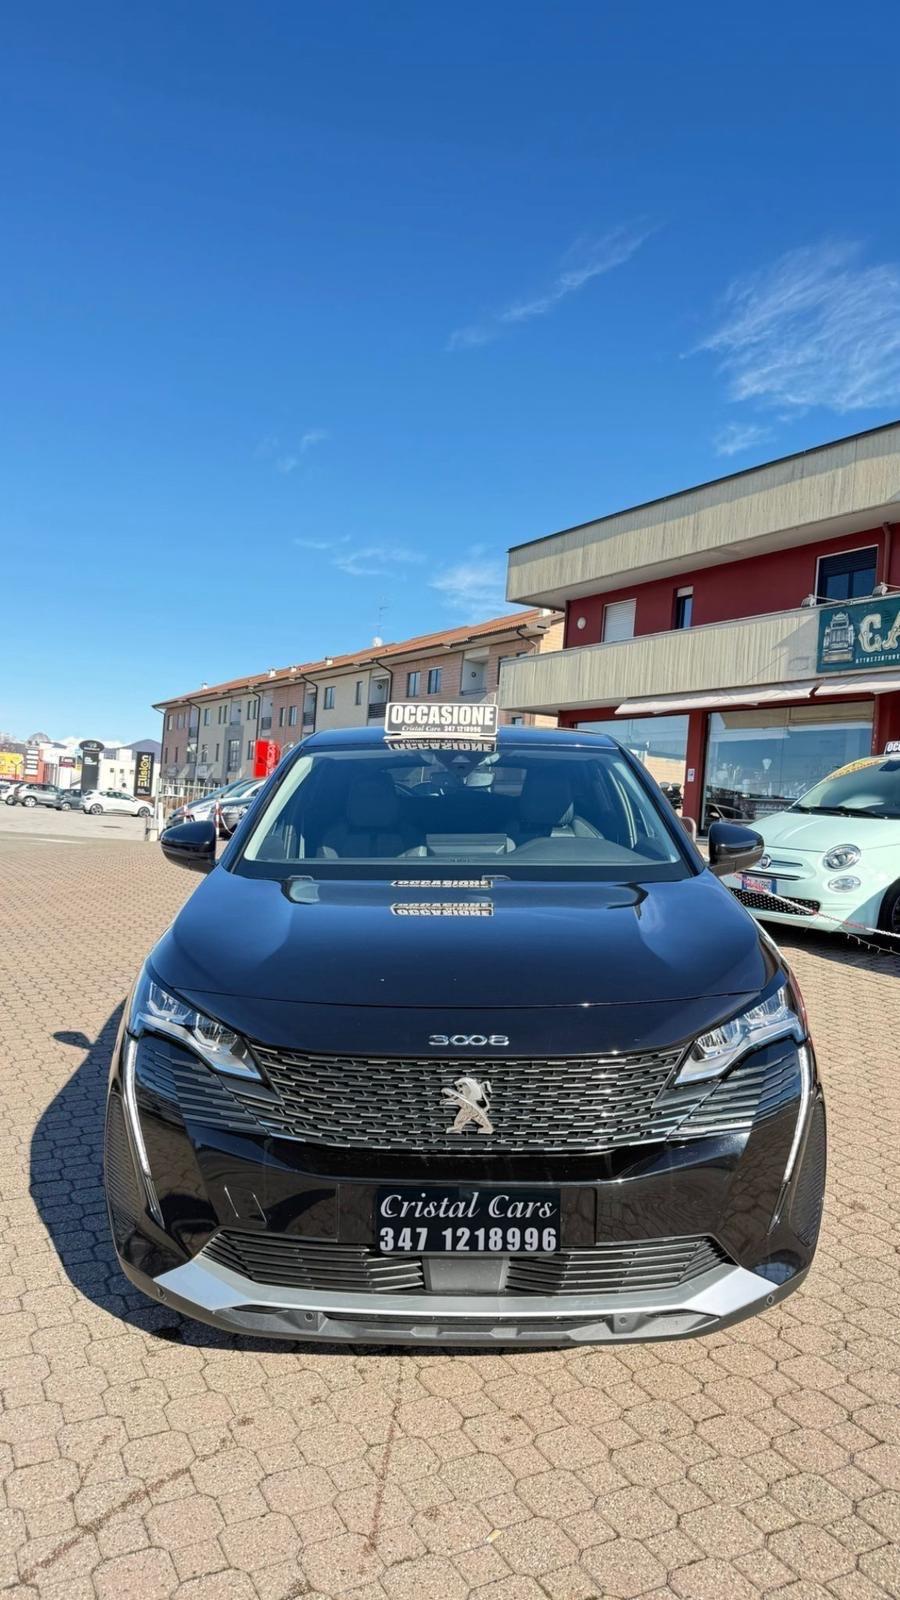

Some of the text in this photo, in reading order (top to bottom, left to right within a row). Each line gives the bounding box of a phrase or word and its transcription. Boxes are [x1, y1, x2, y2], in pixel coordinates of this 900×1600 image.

[391, 705, 494, 726] OCCASIONE
[887, 743, 900, 752] OC
[428, 1034, 510, 1046] 3008
[380, 1191, 557, 1218] Cristal Cars
[379, 1227, 557, 1251] 347 1218996
